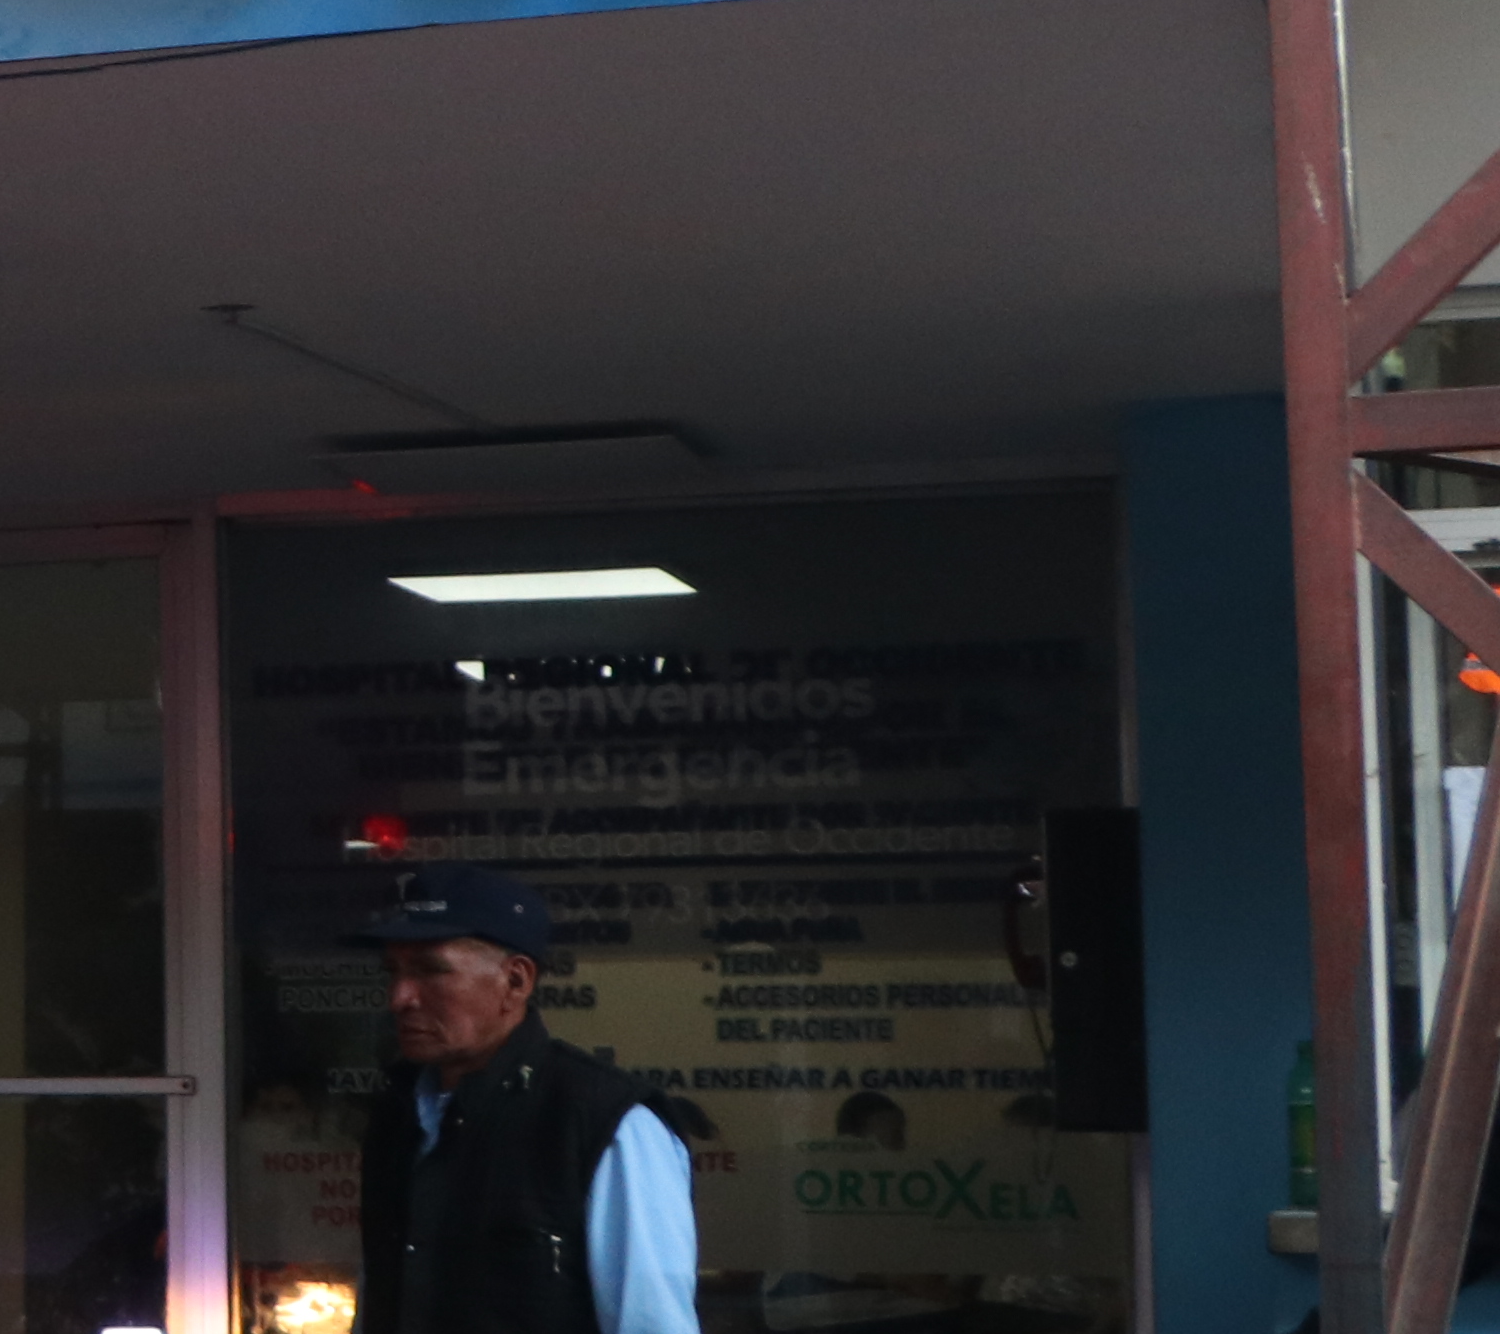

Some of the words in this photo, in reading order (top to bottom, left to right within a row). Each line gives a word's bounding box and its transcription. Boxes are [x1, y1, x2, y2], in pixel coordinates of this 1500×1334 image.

[464, 665, 876, 728] Bienvenidos
[462, 731, 862, 805] Emergencia
[282, 988, 387, 1008] PONCHO
[718, 1018, 767, 1042] DEL
[772, 1017, 895, 1042] PACIENTE
[861, 1068, 970, 1091] GANAR
[977, 1068, 1046, 1091] TIEM
